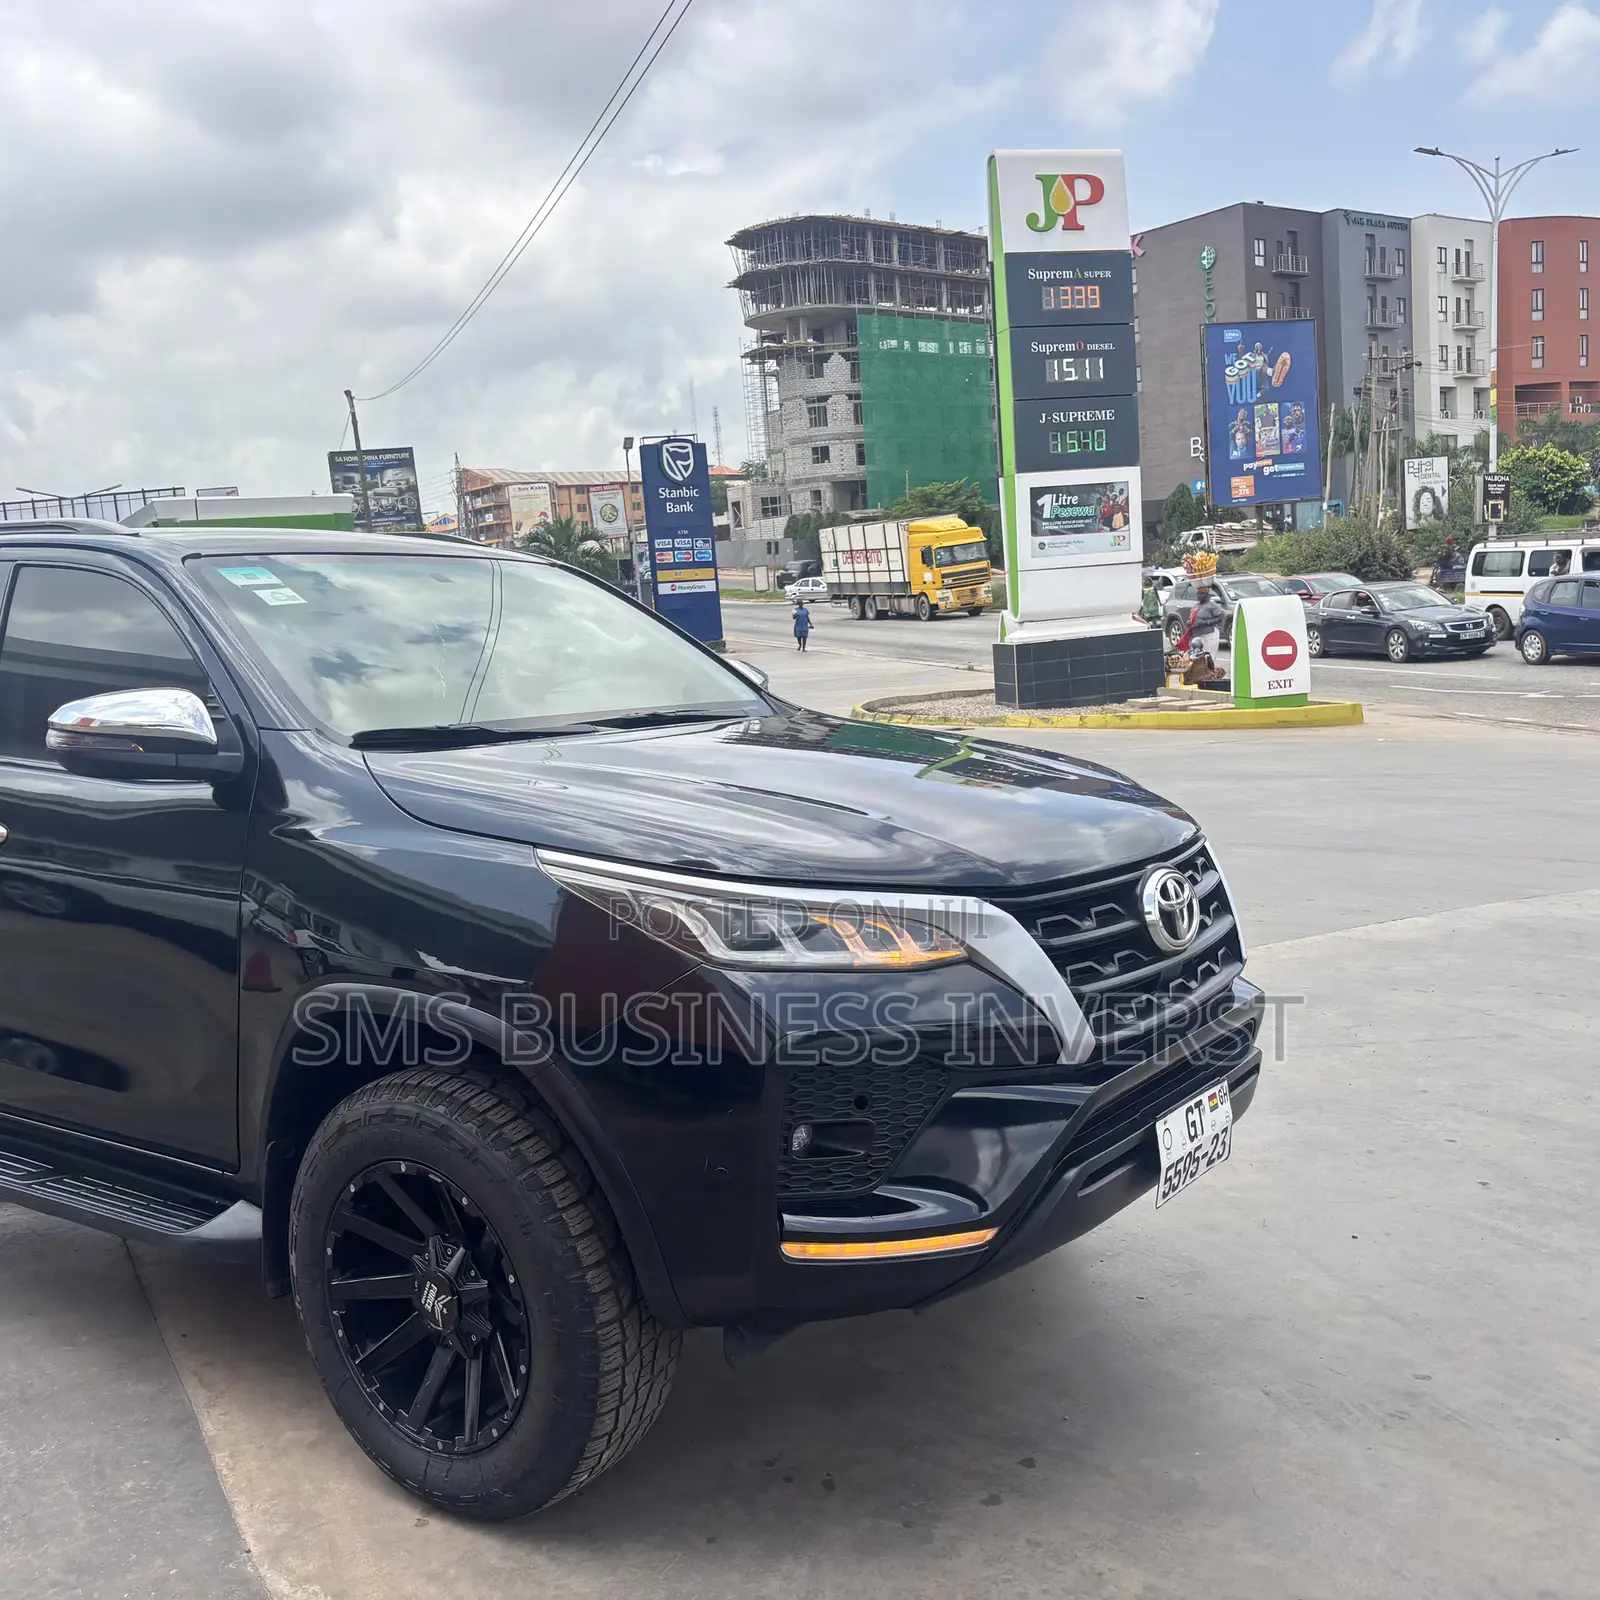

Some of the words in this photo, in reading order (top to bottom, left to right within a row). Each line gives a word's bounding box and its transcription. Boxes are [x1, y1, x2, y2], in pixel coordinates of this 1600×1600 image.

[1026, 173, 1105, 233] JP
[1028, 267, 1082, 281] SupremA
[1084, 270, 1112, 278] SUPER
[1050, 285, 1100, 309] 13.39
[1031, 340, 1085, 355] SupremO
[1087, 343, 1115, 351] DIESEL
[1224, 353, 1238, 366] WE
[1224, 352, 1256, 376] GOT
[1053, 357, 1104, 381] 15.11
[1226, 369, 1257, 405] YOU
[1039, 409, 1115, 424] J-SUPREME
[1057, 429, 1106, 453] 15.40
[379, 452, 410, 460] FURNITURE
[1243, 461, 1258, 472] pay
[1263, 464, 1279, 476] get
[659, 486, 699, 499] Stanbic
[666, 501, 694, 513] Bank
[1036, 493, 1053, 519] 1
[1053, 493, 1079, 506] Litre
[1051, 505, 1096, 518] Pesewa
[1110, 535, 1126, 547] JP
[1267, 678, 1294, 690] EXIT
[1185, 1098, 1205, 1143] GT
[1162, 1126, 1229, 1200] 5595-23
